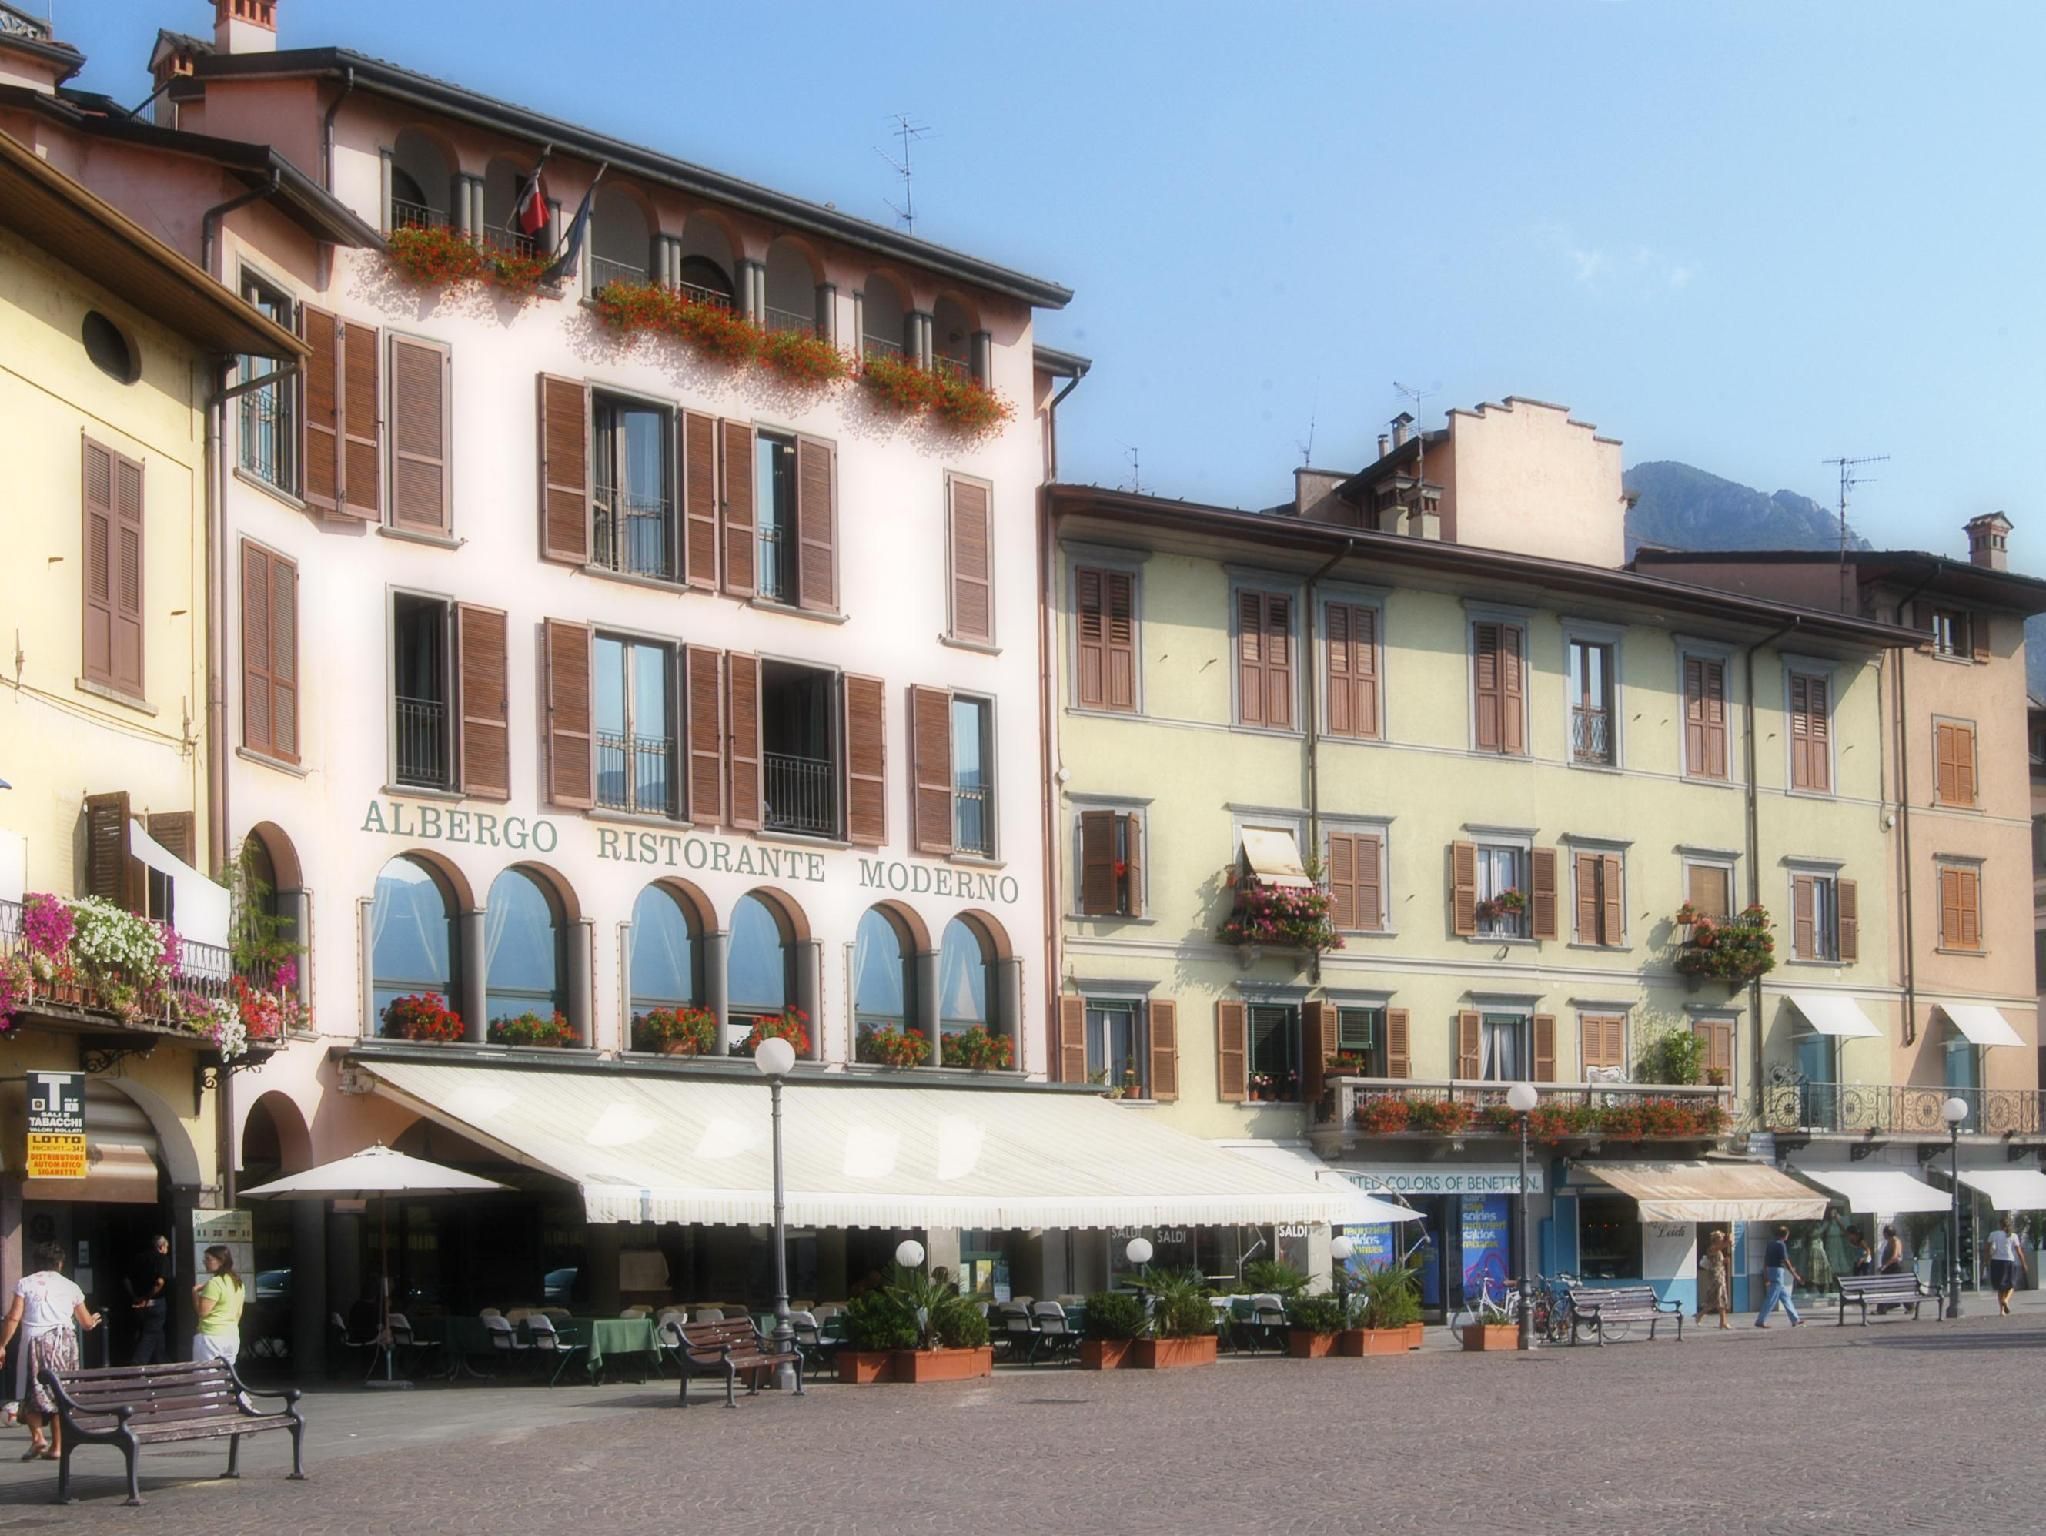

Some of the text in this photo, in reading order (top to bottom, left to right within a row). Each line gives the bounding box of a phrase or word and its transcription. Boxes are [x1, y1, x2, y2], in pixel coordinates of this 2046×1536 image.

[360, 799, 1020, 904] ALBERGO RISTORANTE MODERNO
[38, 1074, 71, 1111] T
[28, 1117, 83, 1127] TABACCHI
[32, 1135, 81, 1144] LOTTO
[31, 1153, 83, 1161] DISTRIBUTORE
[1386, 1175, 1441, 1191] COLORS
[1445, 1175, 1464, 1191] OF
[1111, 1225, 1142, 1240] SALDI
[1156, 1229, 1187, 1244] SALDI
[1279, 1225, 1308, 1238] SALDI
